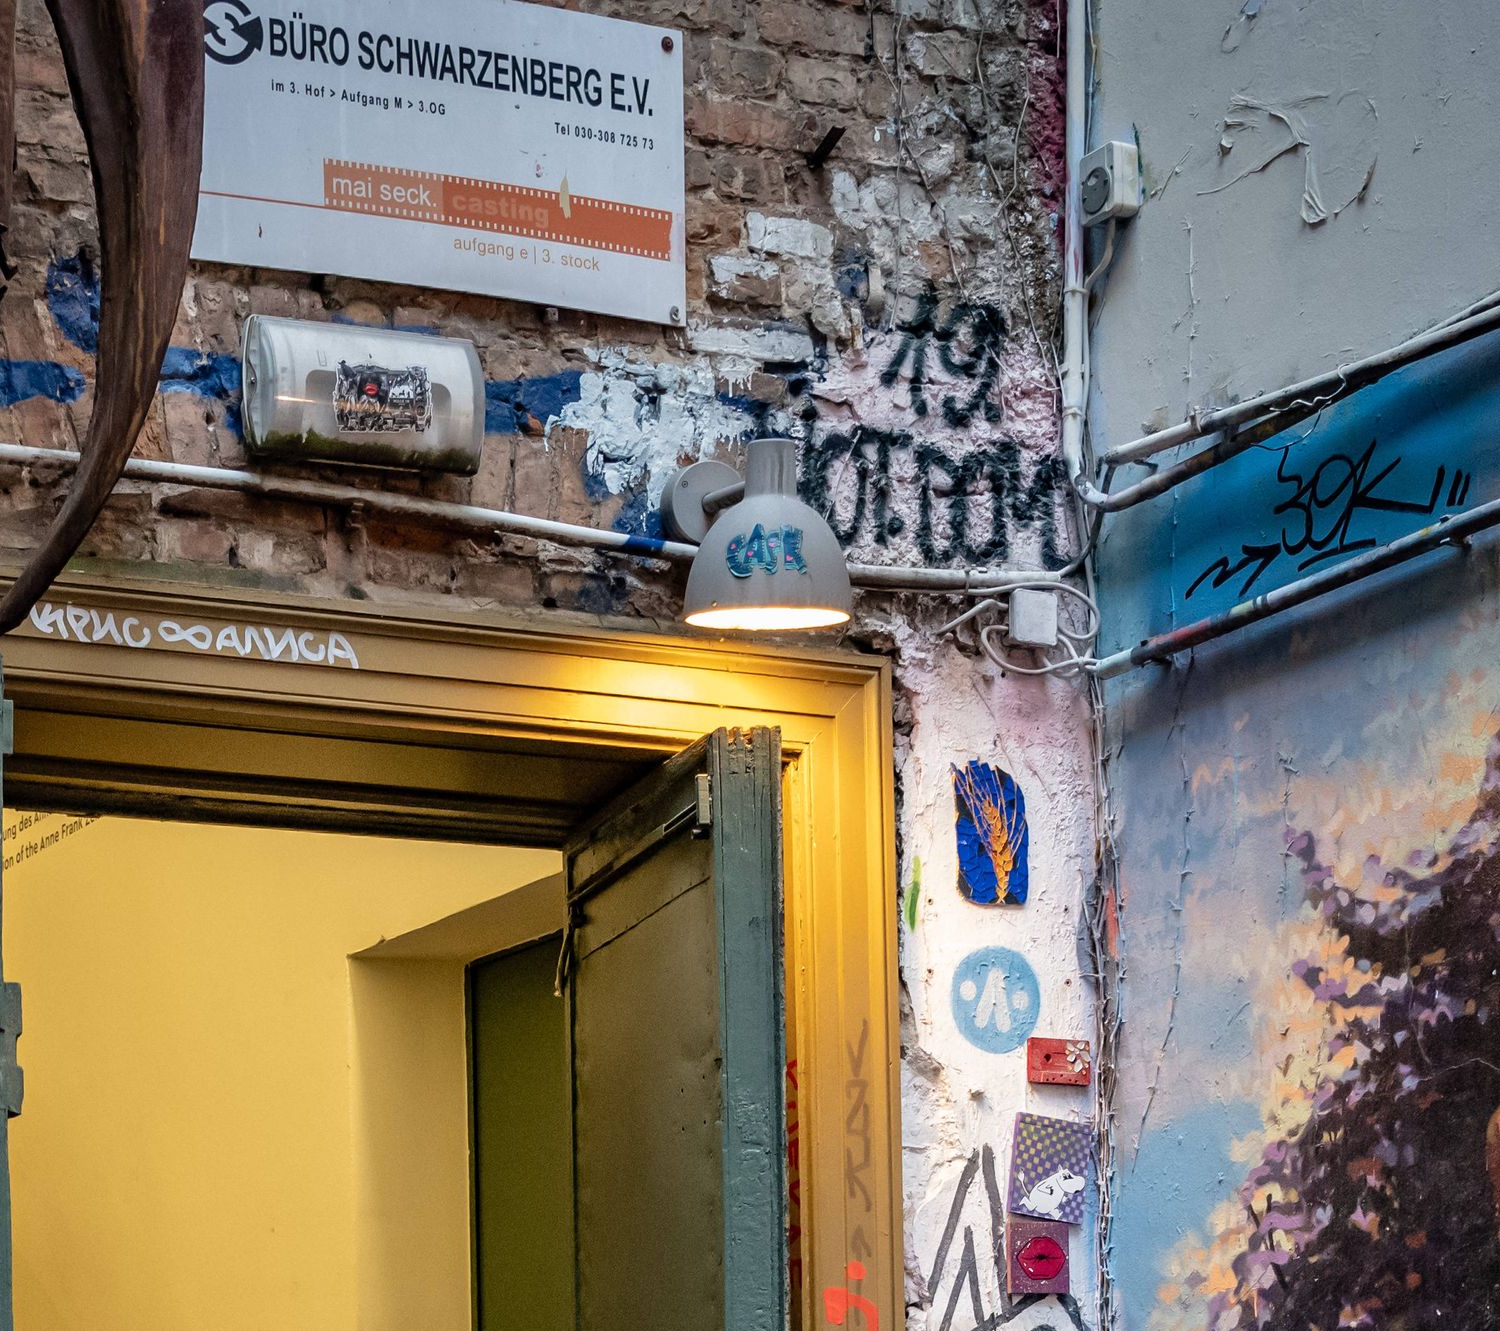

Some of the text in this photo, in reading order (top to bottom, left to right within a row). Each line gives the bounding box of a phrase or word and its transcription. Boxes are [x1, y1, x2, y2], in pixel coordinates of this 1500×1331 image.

[268, 12, 654, 117] BÜRO SCHWARZENBERG E.V.
[271, 78, 446, 116] im 3. Hof Aufgang M 3.OG
[554, 121, 655, 151] Tel 030-308 725 73
[331, 173, 550, 229] mai seck. casting
[453, 236, 600, 272] aufgang e 3. stock
[19, 815, 32, 832] des
[16, 845, 25, 864] of
[25, 841, 38, 859] the
[40, 830, 59, 851] Anne
